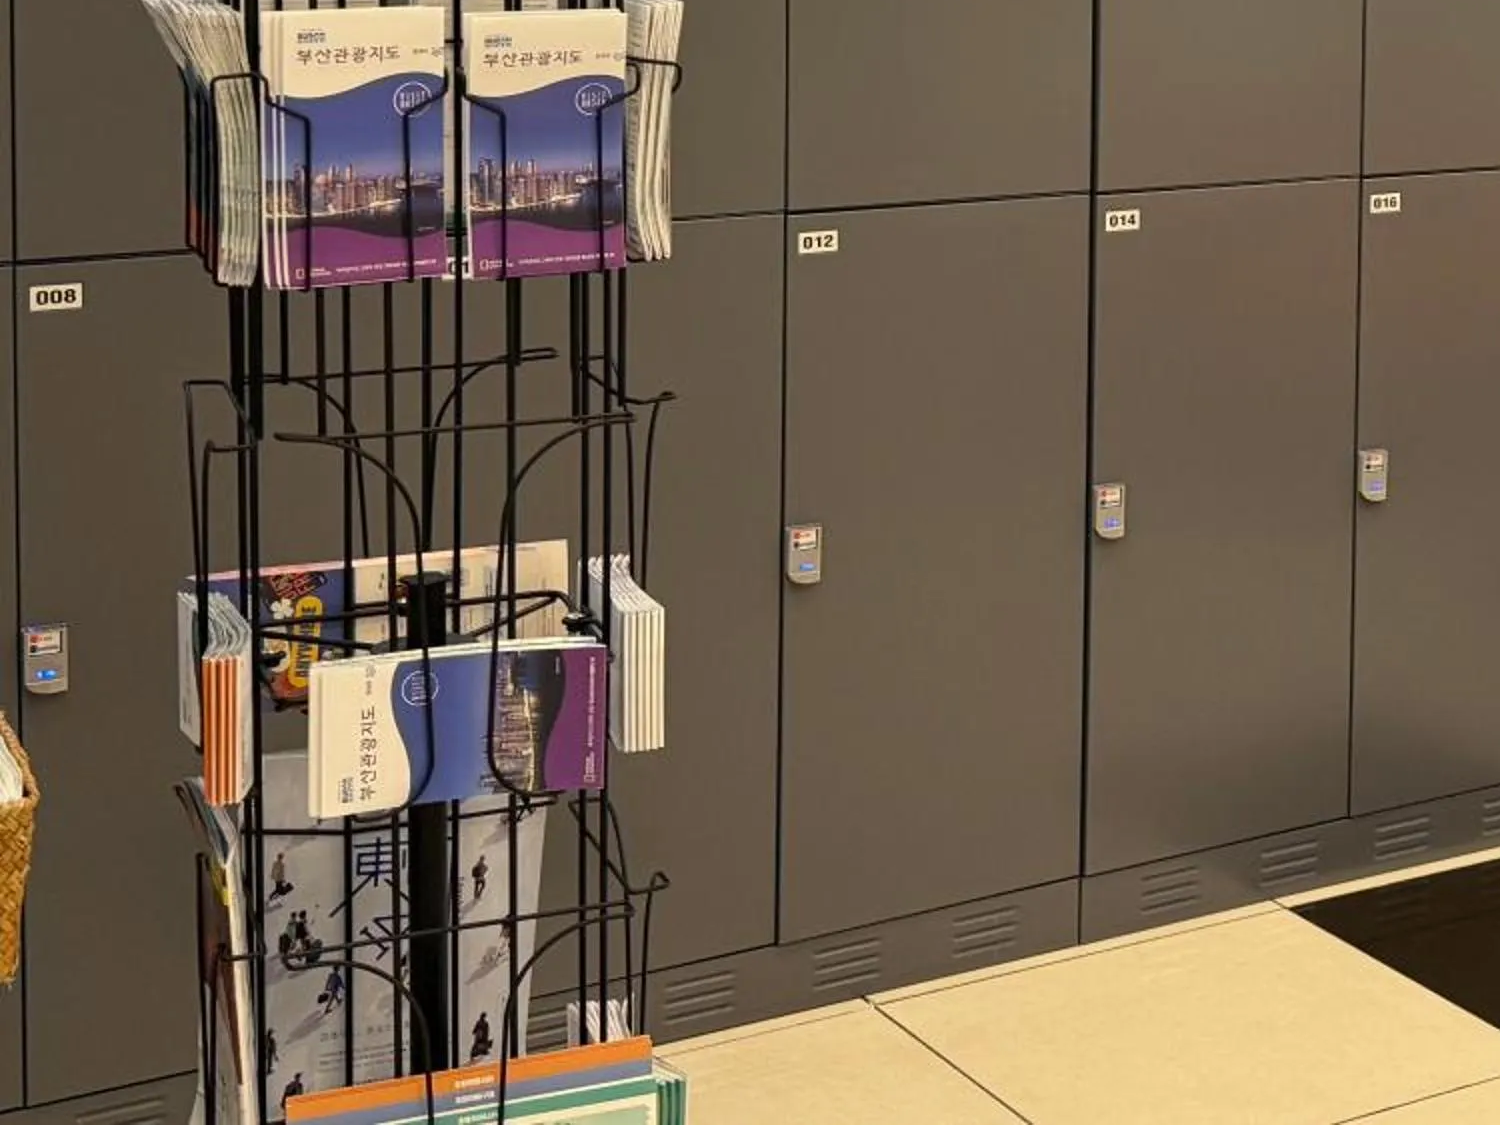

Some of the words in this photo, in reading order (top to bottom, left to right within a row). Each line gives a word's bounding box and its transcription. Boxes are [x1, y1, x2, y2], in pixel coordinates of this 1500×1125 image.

[296, 45, 401, 65] 부산관광지도
[483, 50, 583, 68] 부산관광지도
[1373, 196, 1399, 211] 016
[1108, 213, 1137, 229] 014
[802, 234, 835, 251] 012
[35, 288, 78, 307] 008
[360, 706, 376, 802] 부산관광지도
